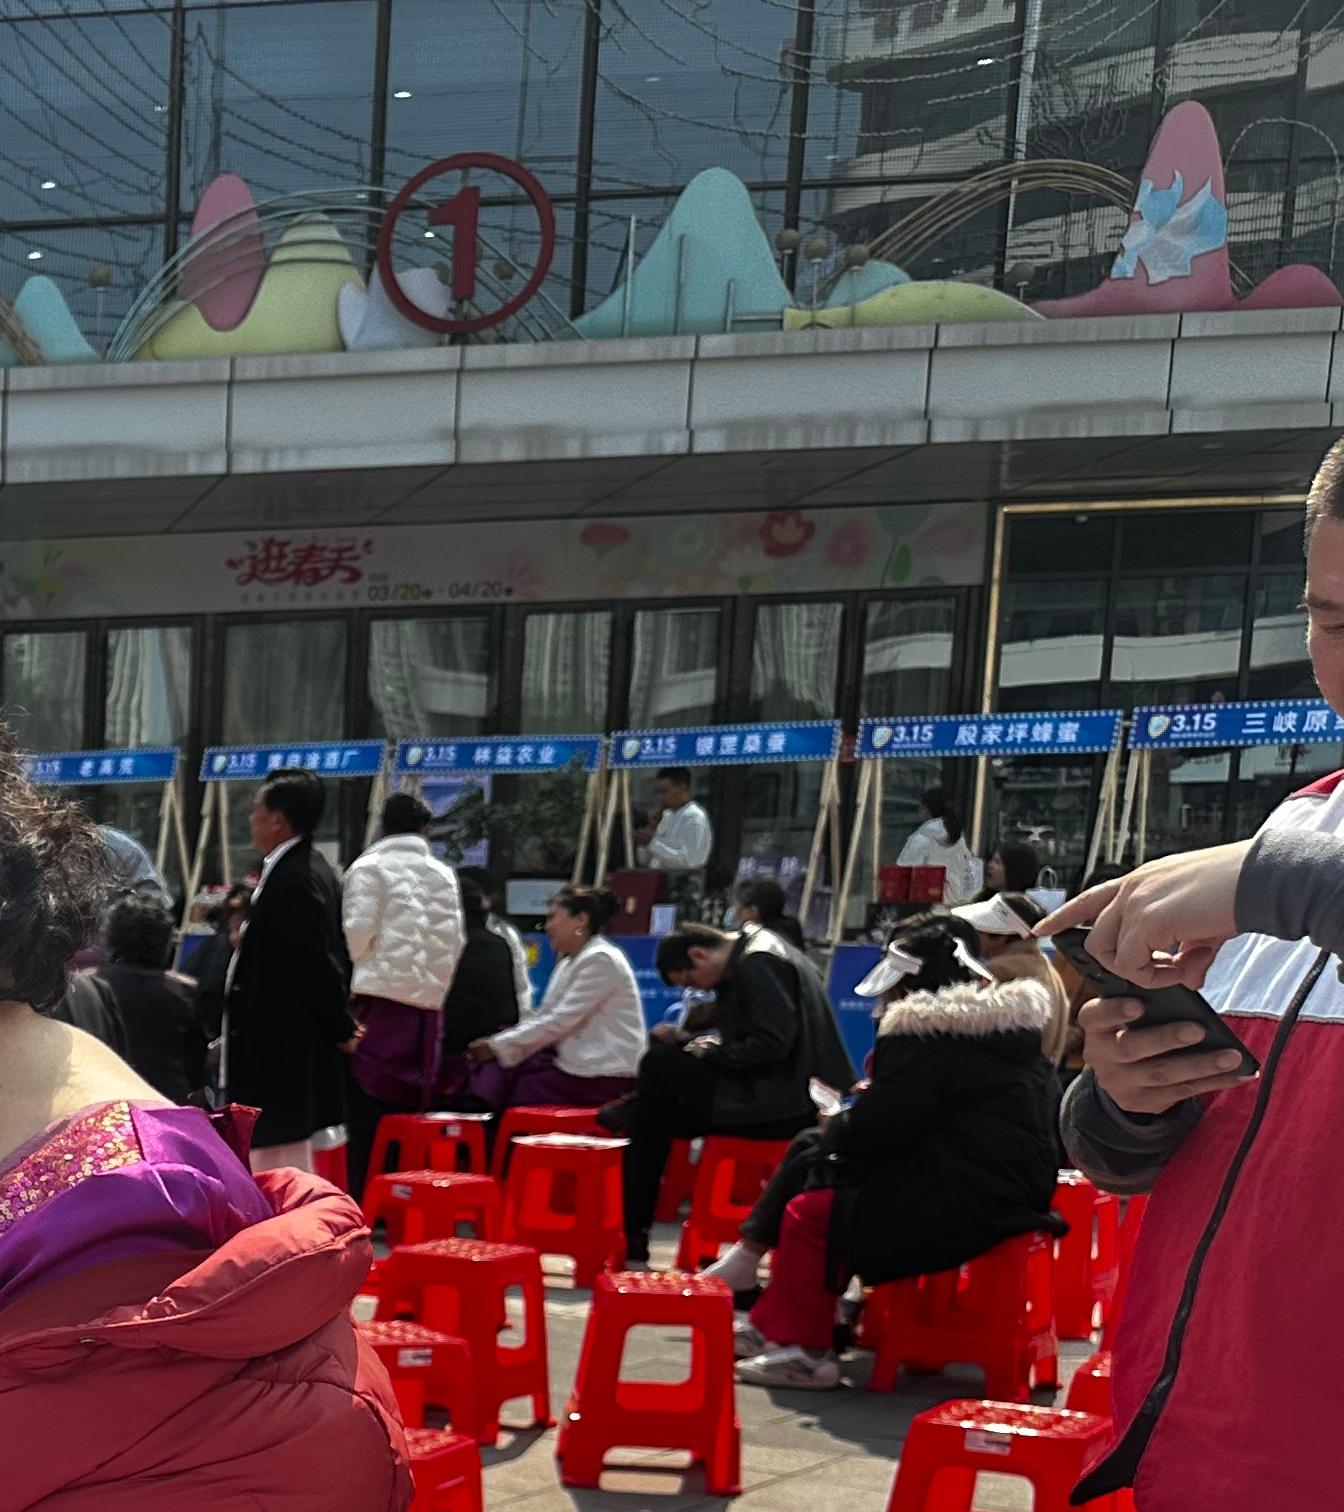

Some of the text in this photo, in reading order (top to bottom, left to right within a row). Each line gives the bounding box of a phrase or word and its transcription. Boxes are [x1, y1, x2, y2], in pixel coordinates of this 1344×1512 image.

[427, 186, 481, 301] 1
[235, 537, 364, 586] 逛春天
[893, 724, 934, 743] 3.15
[1171, 712, 1218, 732] 3.15
